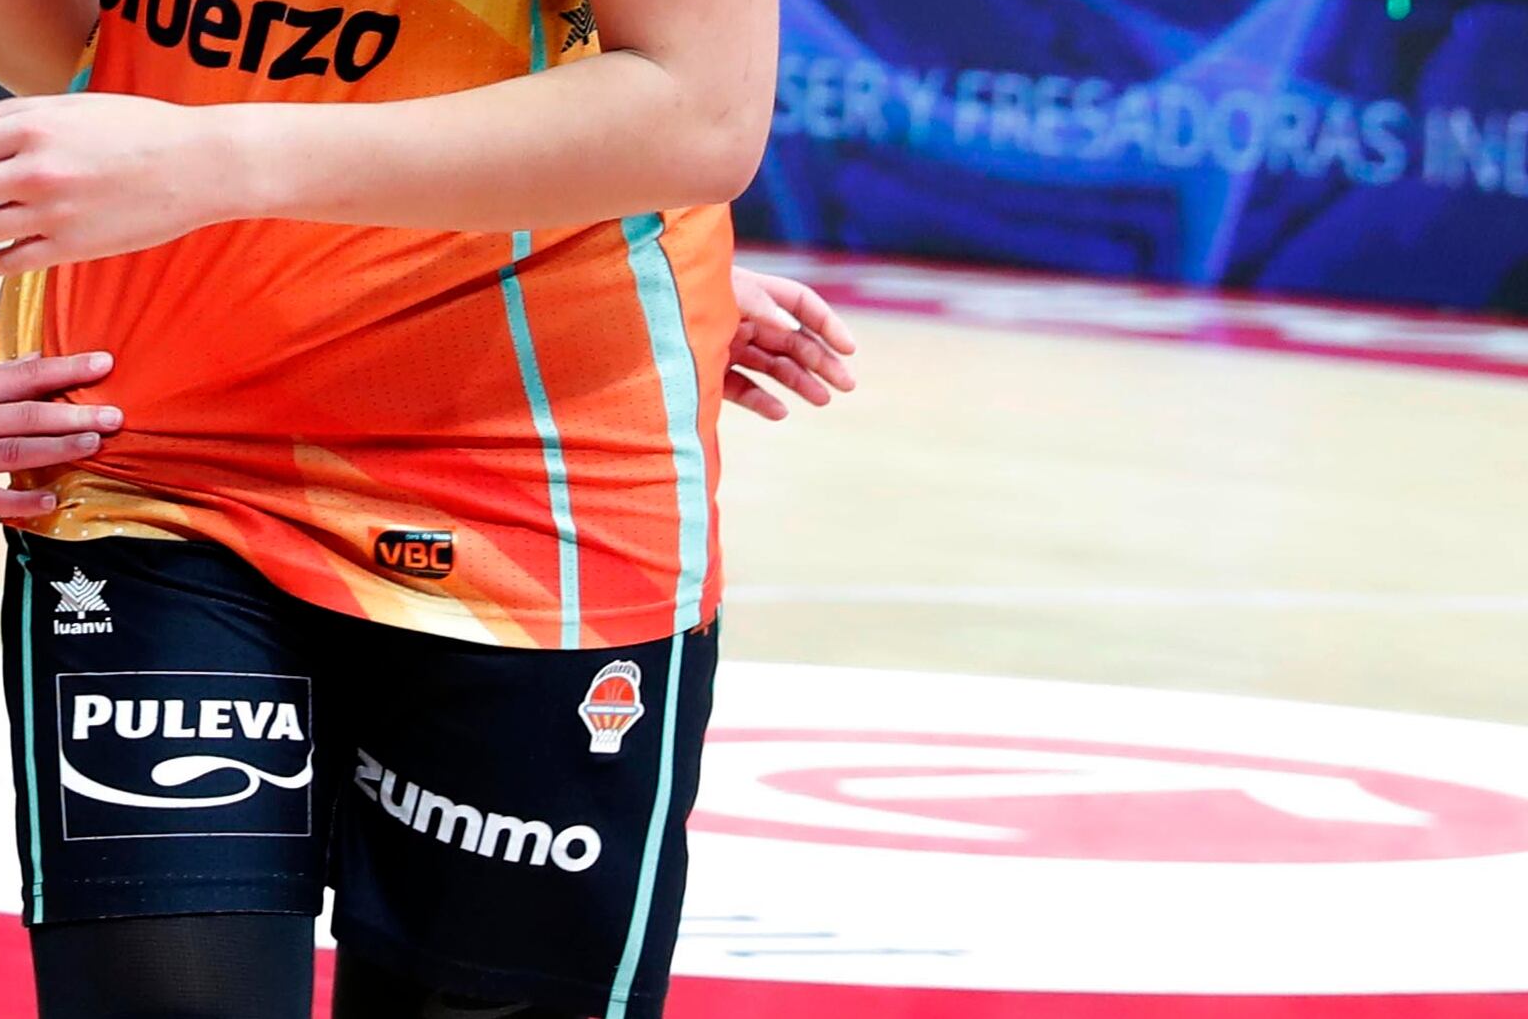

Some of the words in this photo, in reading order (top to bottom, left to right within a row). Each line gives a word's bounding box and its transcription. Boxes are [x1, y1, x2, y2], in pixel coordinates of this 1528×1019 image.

[954, 70, 1408, 187] FRESADORAS
[379, 542, 451, 569] VBC
[53, 617, 113, 635] luanvi
[73, 694, 305, 741] PULEVA
[354, 748, 601, 872] zummo
